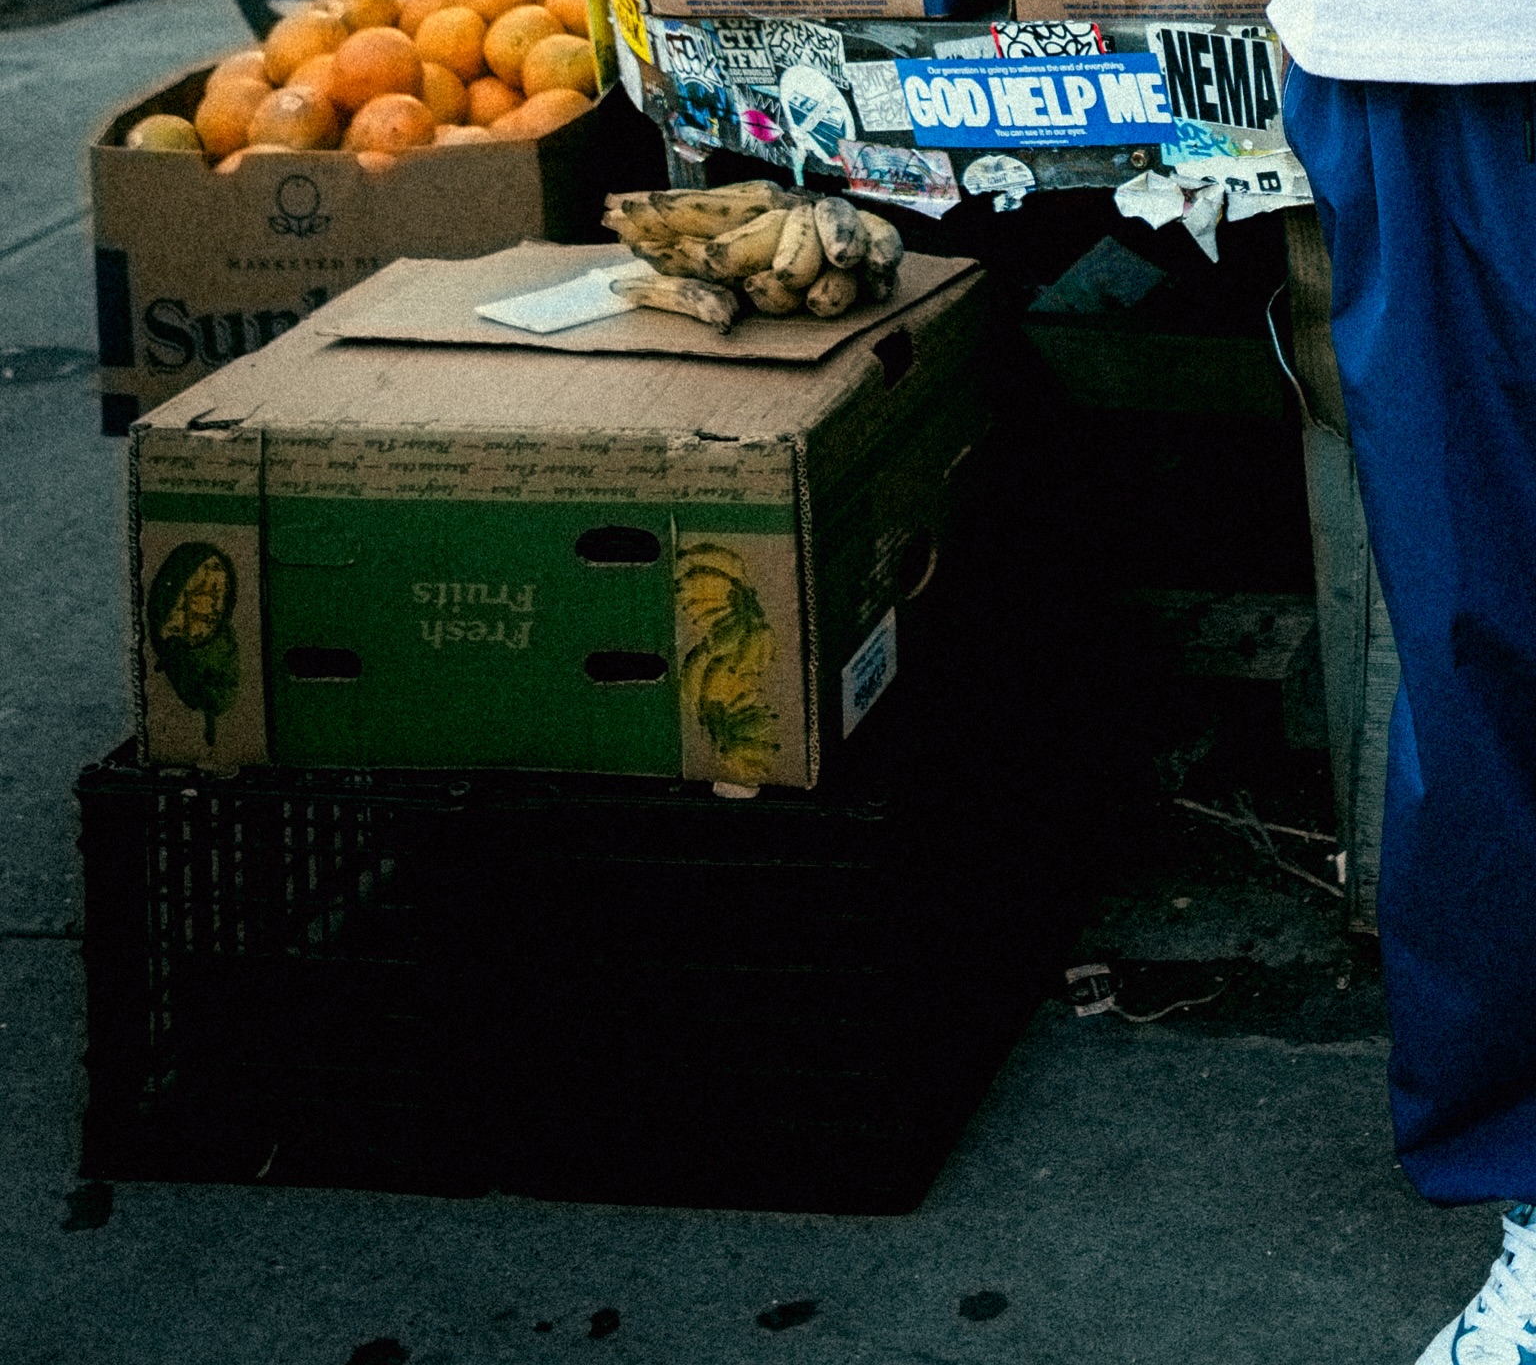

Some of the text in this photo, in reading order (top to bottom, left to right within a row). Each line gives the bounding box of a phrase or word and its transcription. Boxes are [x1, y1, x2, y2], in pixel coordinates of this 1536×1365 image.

[943, 65, 979, 77] generation
[988, 65, 1008, 77] going
[904, 74, 991, 128] GOD
[988, 73, 1098, 127] HELP
[1098, 71, 1173, 124] ME
[994, 128, 1010, 137] You
[1010, 128, 1024, 137] can
[1024, 127, 1038, 137] see
[1053, 127, 1067, 136] our
[228, 257, 345, 270] MARKETED
[144, 286, 328, 375] Sun
[411, 582, 537, 613] Fruits
[420, 619, 534, 651] Fresh
